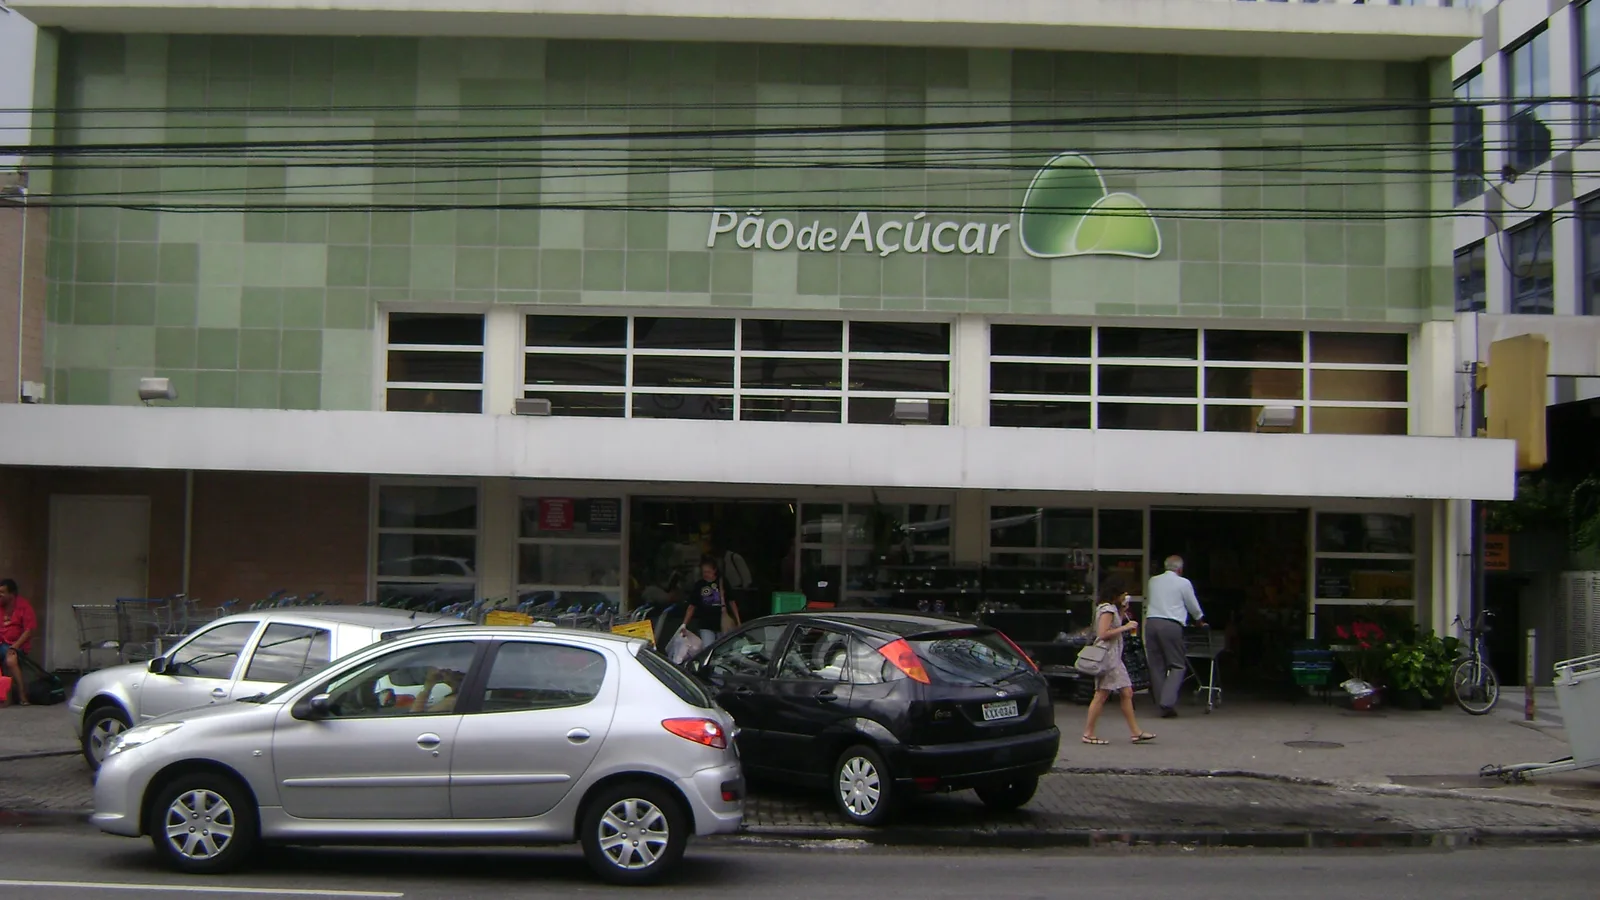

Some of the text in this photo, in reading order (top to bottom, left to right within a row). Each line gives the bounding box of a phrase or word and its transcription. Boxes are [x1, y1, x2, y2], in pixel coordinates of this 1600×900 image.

[707, 207, 1010, 257] Pão de Açúcar
